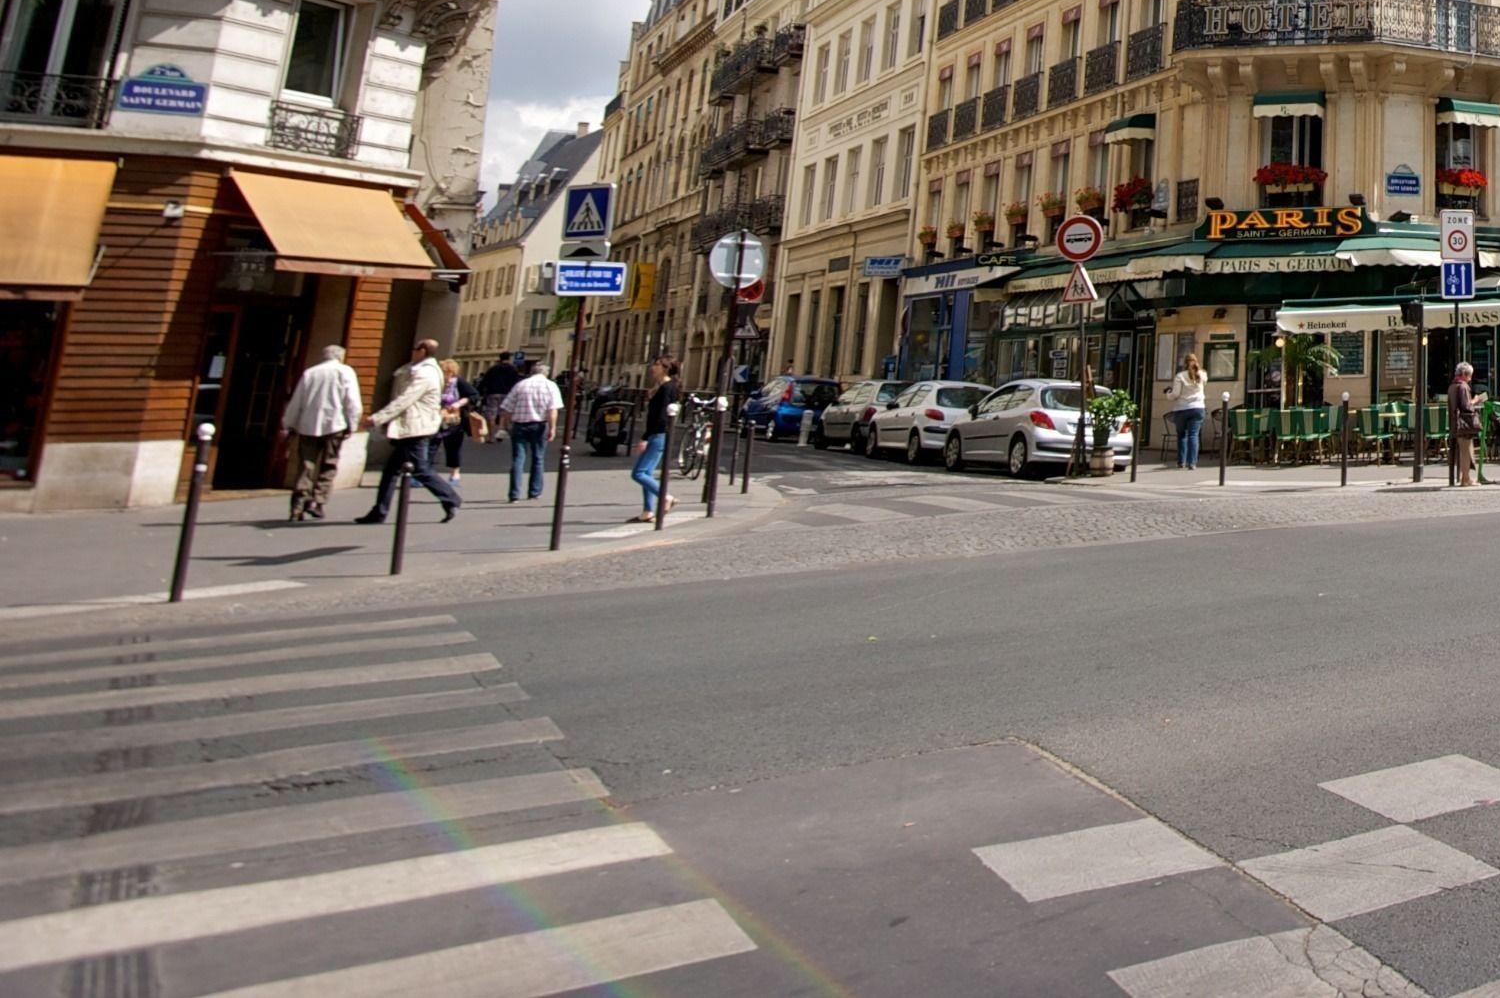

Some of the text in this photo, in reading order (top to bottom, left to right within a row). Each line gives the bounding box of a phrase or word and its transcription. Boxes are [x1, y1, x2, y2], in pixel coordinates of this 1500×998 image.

[1204, 1, 1368, 34] HOTEL
[132, 85, 197, 98] BOULEVARD
[122, 96, 202, 109] SAINT GERMAIN
[1206, 207, 1363, 241] PARIS
[1447, 216, 1469, 224] ZONE
[1236, 230, 1266, 239] SAINT
[1278, 228, 1327, 238] GERMAIN
[1452, 236, 1464, 245] 30
[1220, 259, 1261, 272] PARIS
[1267, 259, 1280, 270] St
[1287, 257, 1351, 270] GERMAIN
[1306, 320, 1347, 330] Heineken
